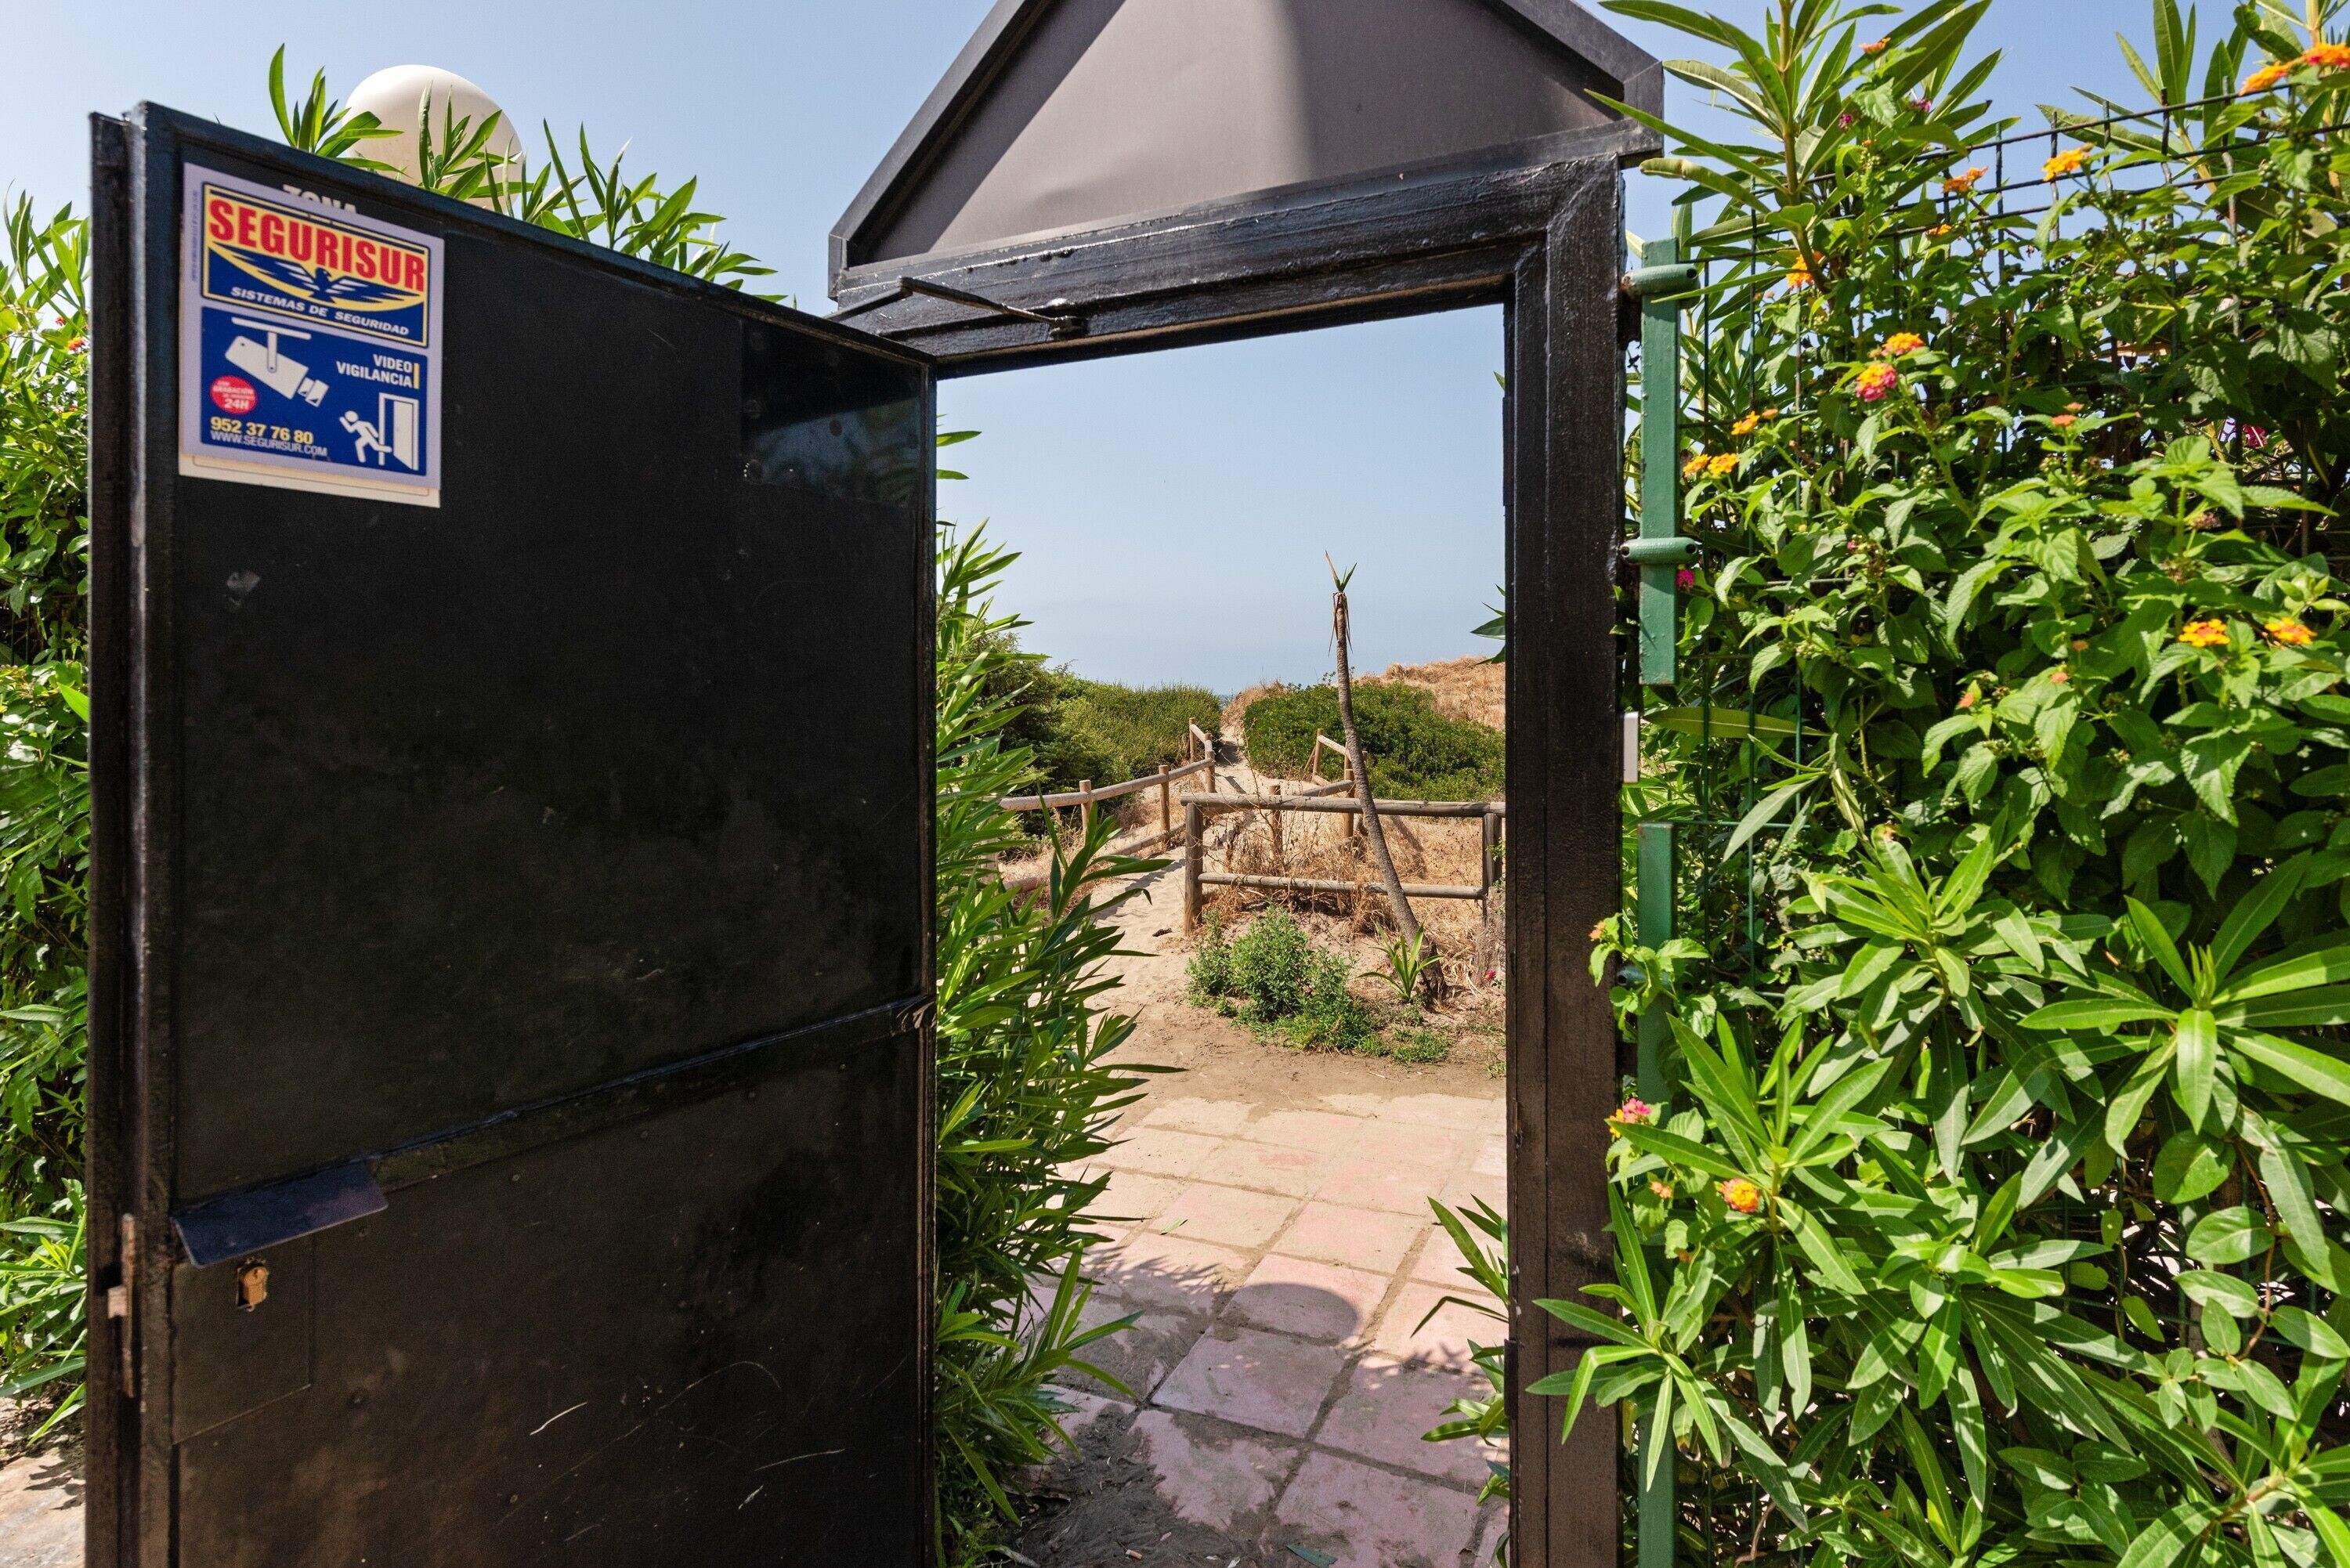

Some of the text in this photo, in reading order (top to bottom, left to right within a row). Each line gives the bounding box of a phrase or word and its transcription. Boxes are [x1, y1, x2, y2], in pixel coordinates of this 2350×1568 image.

[208, 199, 425, 292] SEGURISUR
[231, 287, 410, 335] SISTEMAS DE SEGURIDAD
[336, 361, 413, 388] VIGILANCIA
[373, 353, 413, 374] VIDEO
[224, 398, 249, 410] 24H
[210, 416, 313, 444] 952 37 76 80
[210, 430, 327, 457] WWW.SEGURISUR.COM
